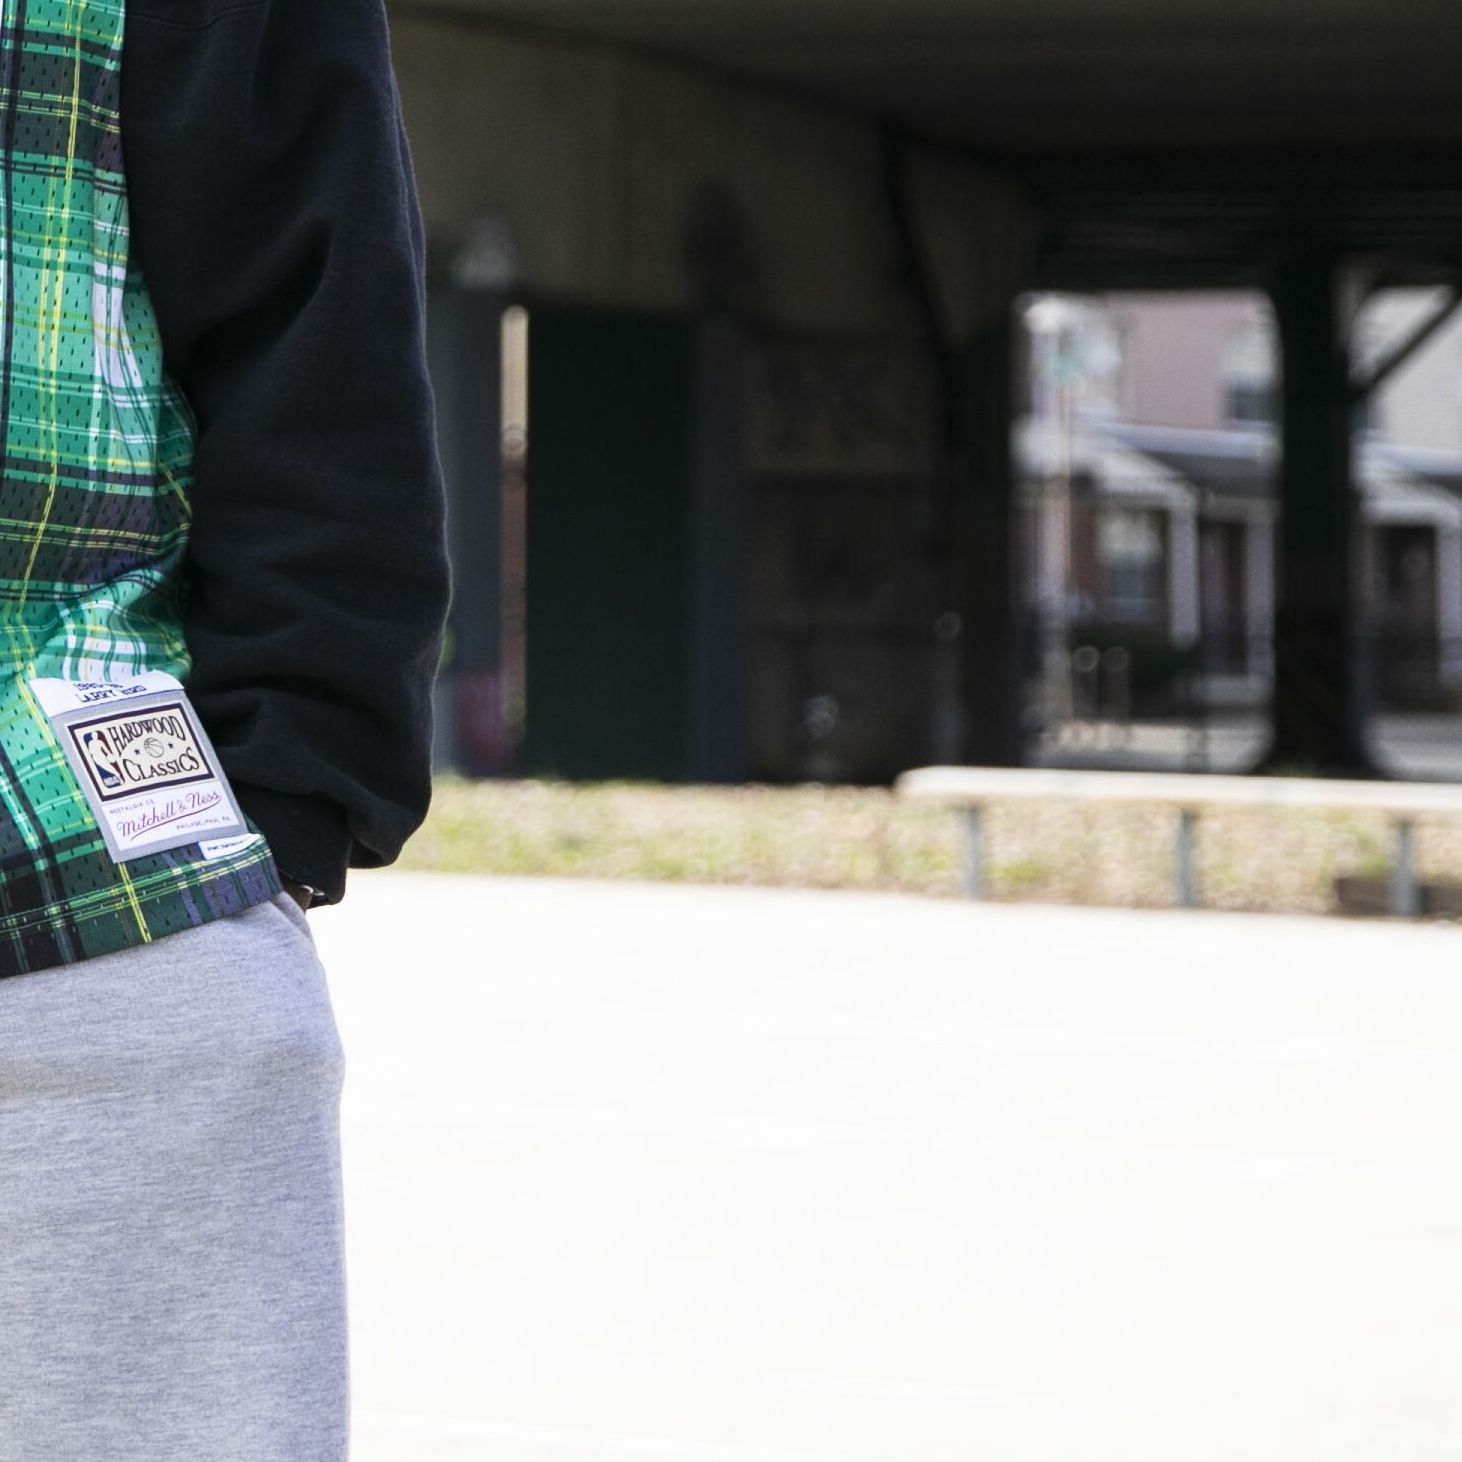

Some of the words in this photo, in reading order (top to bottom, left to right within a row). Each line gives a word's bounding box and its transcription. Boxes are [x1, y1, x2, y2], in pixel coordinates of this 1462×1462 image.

[107, 716, 186, 757] HARDWOOD
[117, 802, 175, 837] Mitchell
[177, 800, 189, 813] &
[186, 790, 220, 809] Ness
